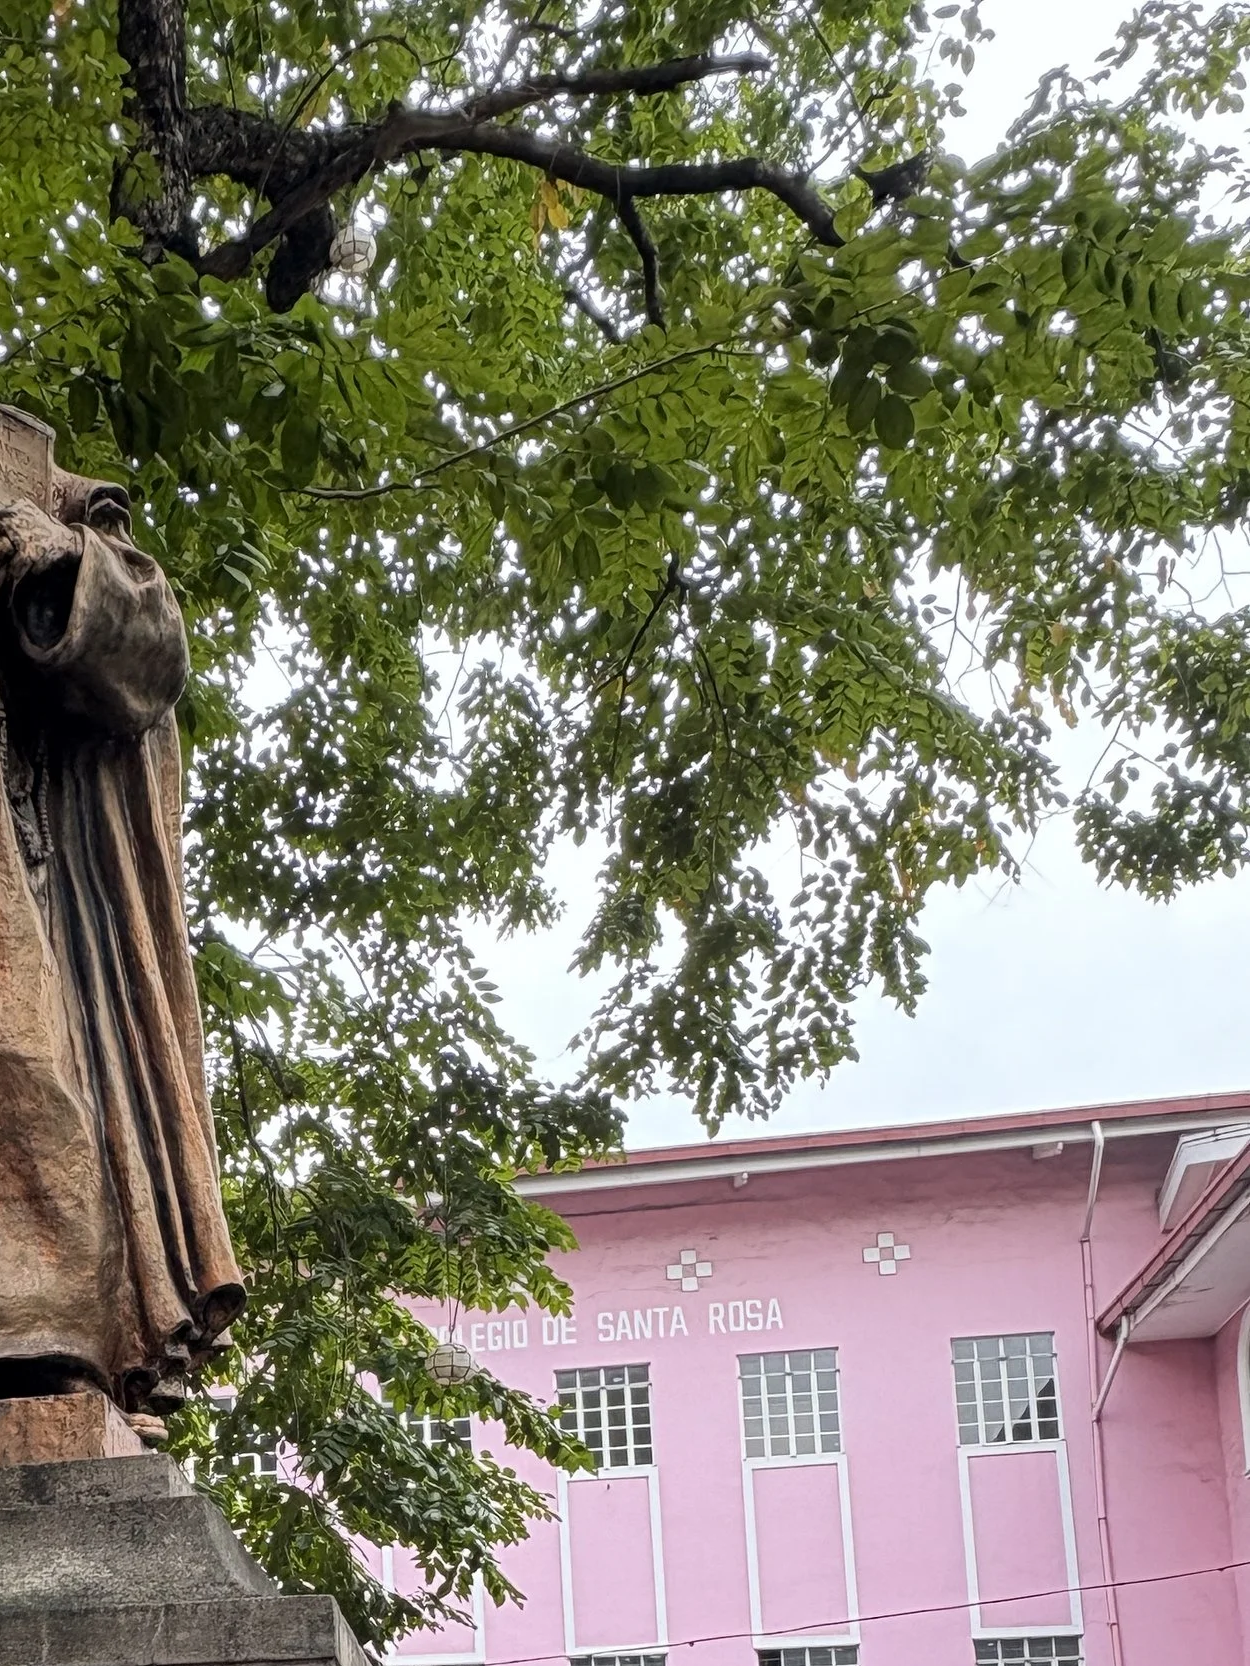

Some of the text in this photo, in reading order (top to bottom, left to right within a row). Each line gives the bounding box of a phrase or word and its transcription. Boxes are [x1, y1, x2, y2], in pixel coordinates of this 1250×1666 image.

[542, 1315, 577, 1346] DE
[597, 1306, 689, 1342] SANTA
[708, 1298, 784, 1335] ROSA
